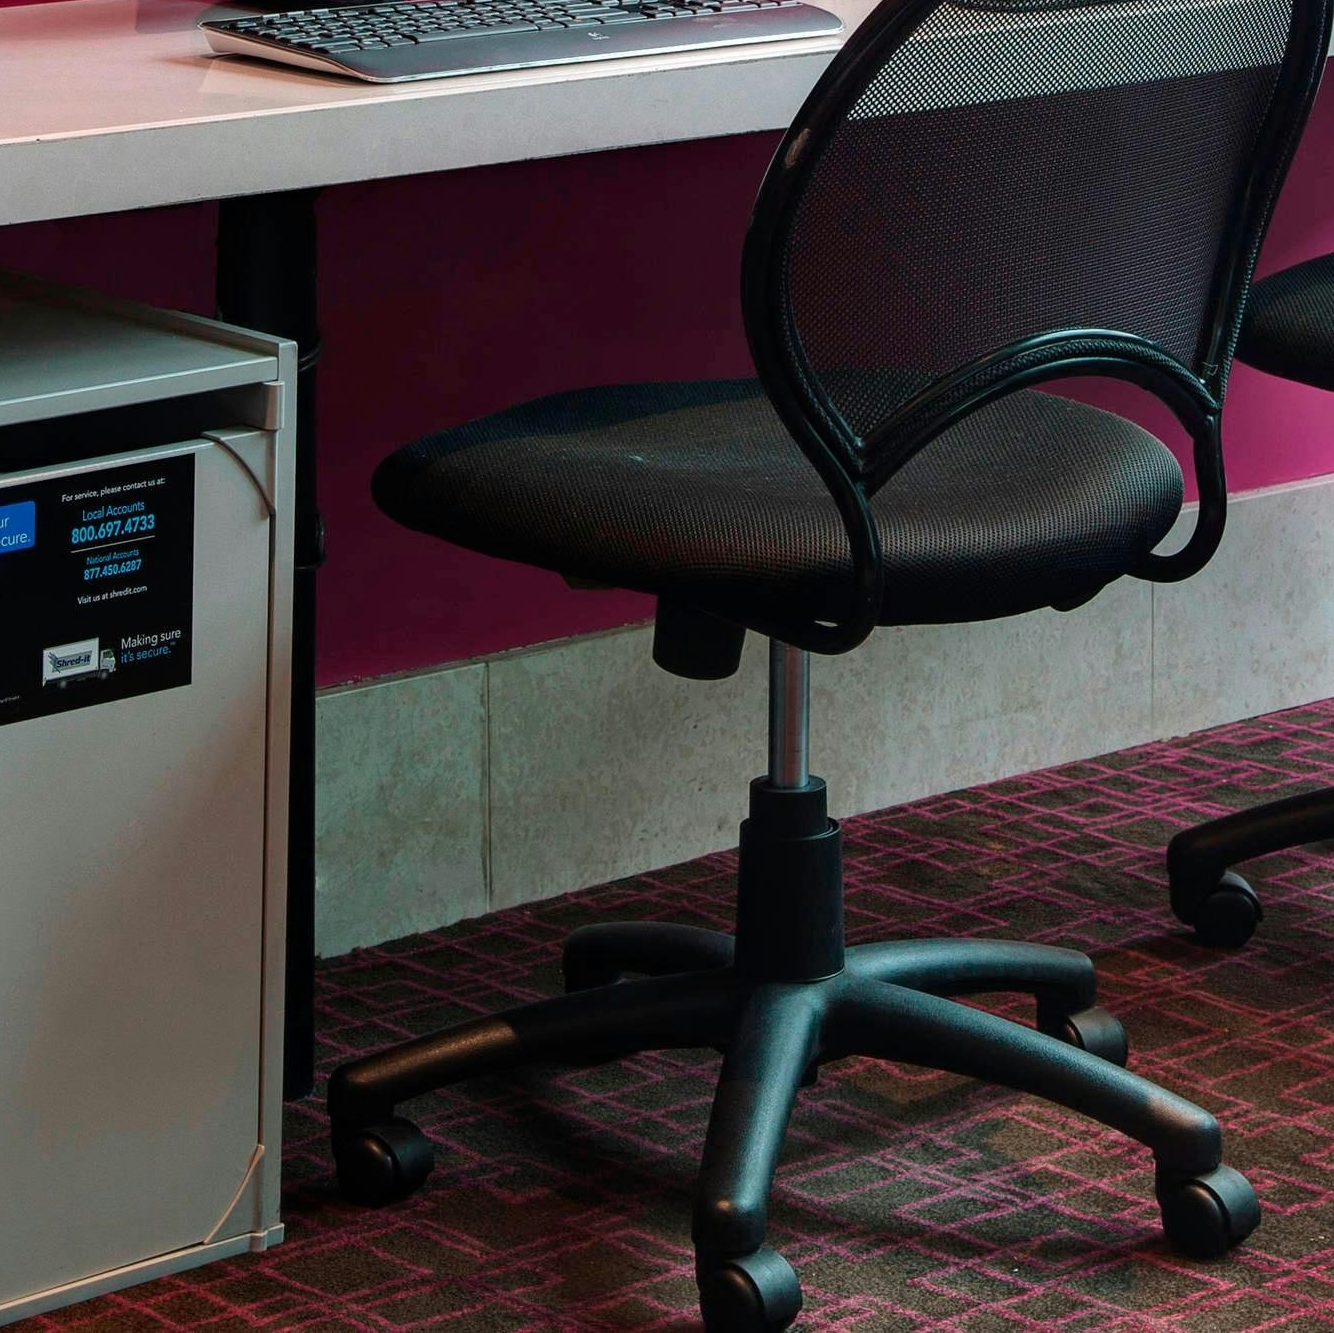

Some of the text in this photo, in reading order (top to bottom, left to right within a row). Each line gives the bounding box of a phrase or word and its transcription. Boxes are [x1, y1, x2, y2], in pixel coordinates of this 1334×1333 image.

[61, 477, 166, 503] For service, please contact us at:
[82, 501, 145, 521] Local Accounts
[71, 513, 155, 545] 800.697.4733
[86, 548, 140, 565] National Accounts
[83, 559, 142, 580] 877.450.6287
[77, 585, 147, 604] Visit us at shredit.com
[121, 628, 182, 649] Making sure
[56, 653, 91, 668] Shred-it
[120, 647, 172, 664] it's secure.
